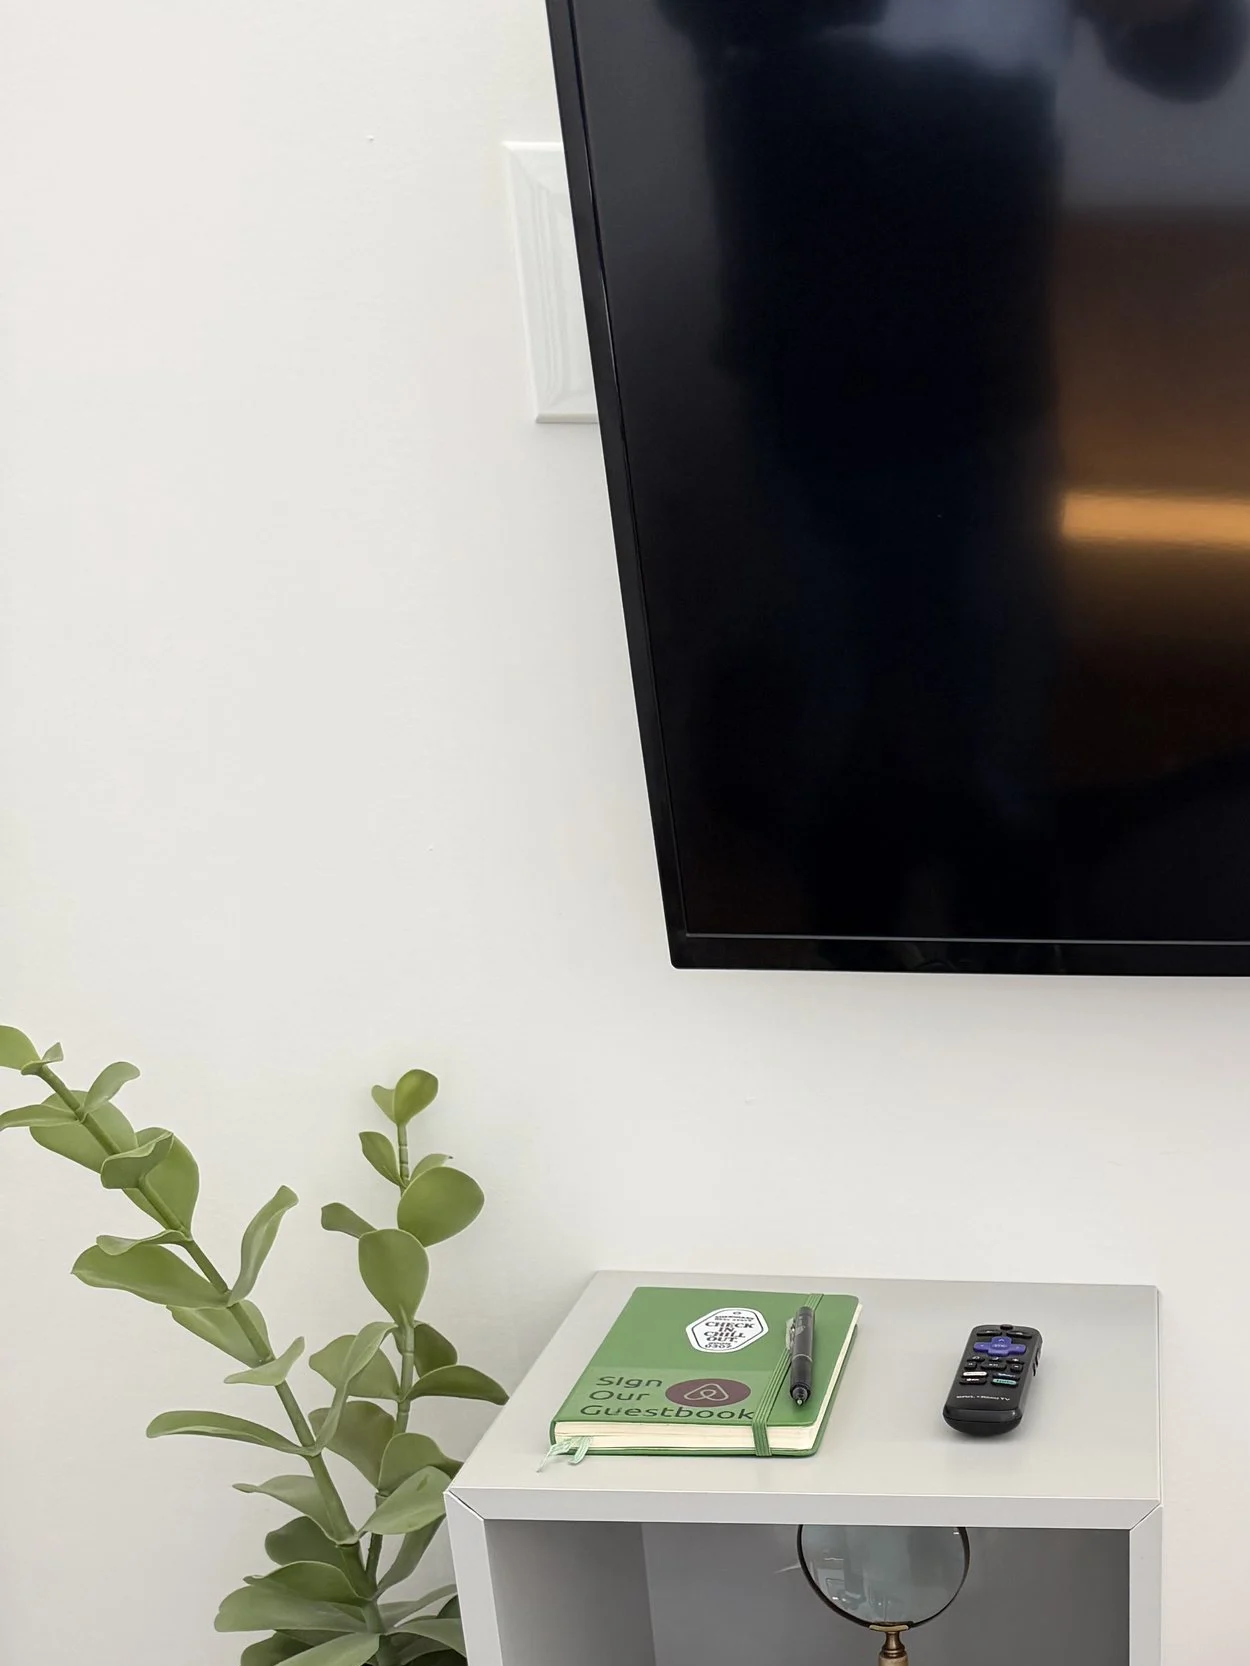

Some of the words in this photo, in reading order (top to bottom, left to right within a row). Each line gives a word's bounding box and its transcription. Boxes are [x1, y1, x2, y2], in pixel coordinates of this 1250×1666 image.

[705, 1321, 755, 1329] CHECK
[589, 1390, 650, 1401] Our
[580, 1404, 755, 1420] Guestbook
